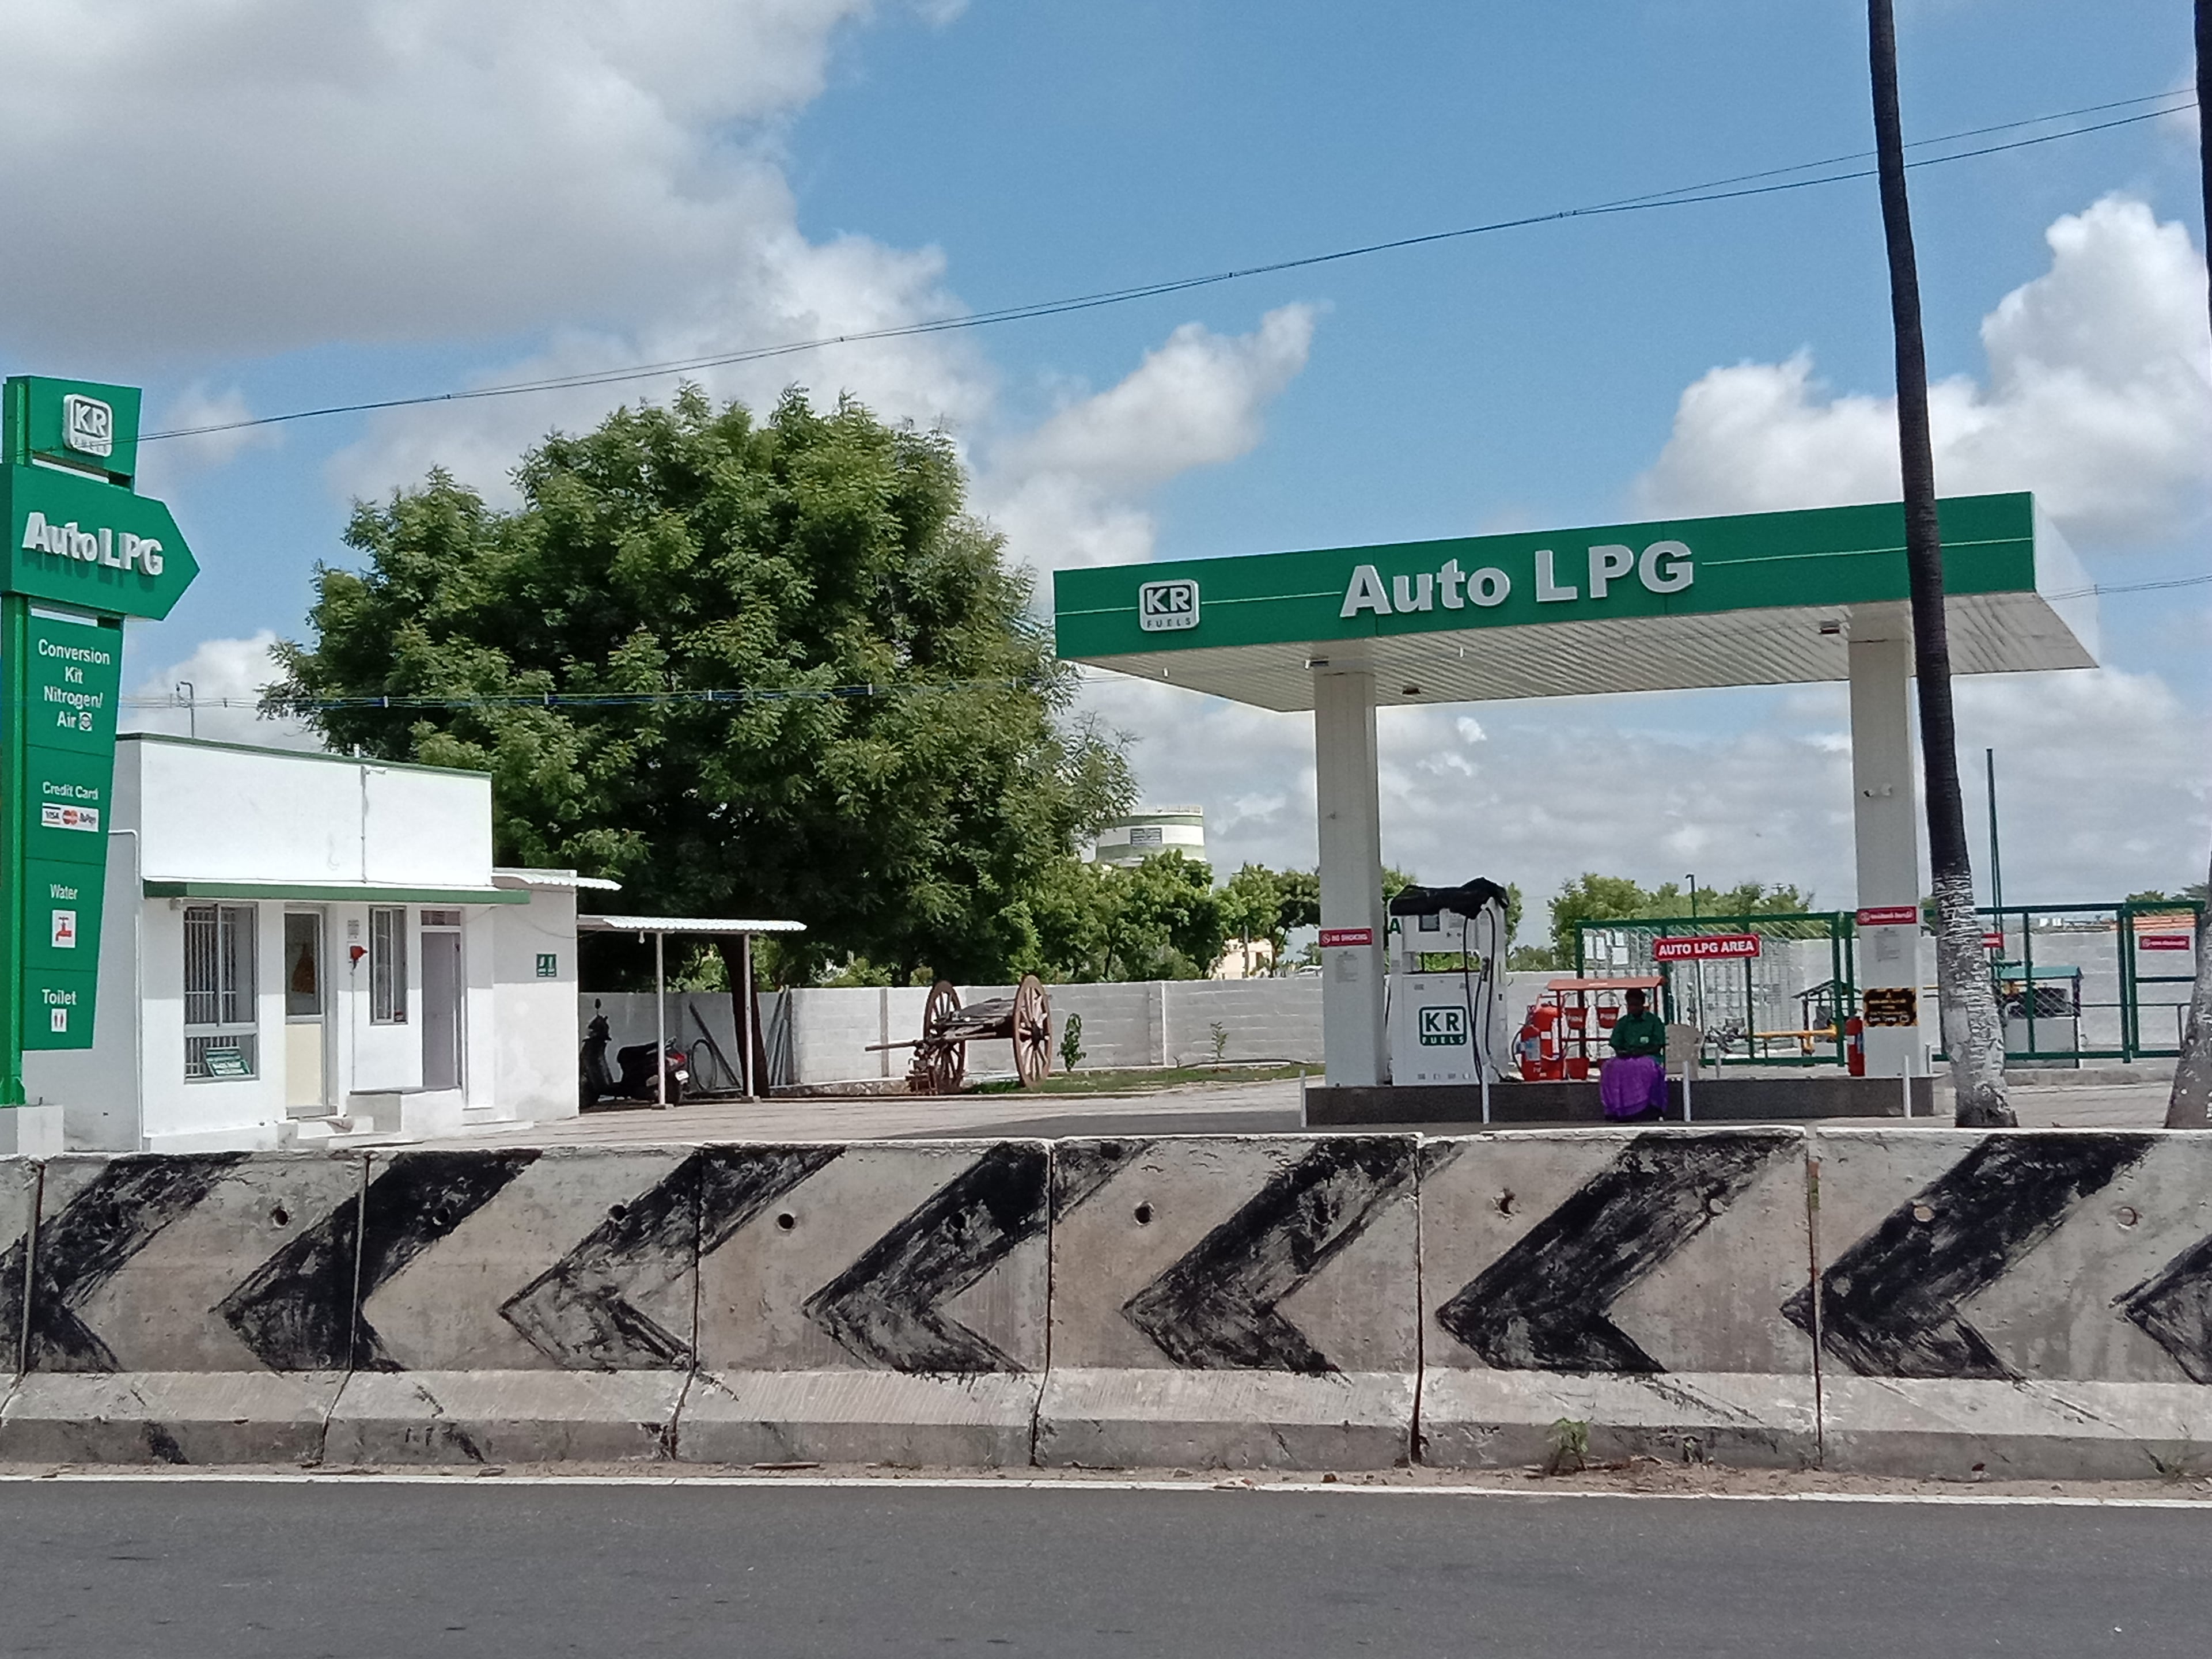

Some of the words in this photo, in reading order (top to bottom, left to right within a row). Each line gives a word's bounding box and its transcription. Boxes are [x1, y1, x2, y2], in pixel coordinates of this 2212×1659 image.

[75, 403, 106, 436] KR
[1340, 558, 1511, 618] Auto
[1535, 540, 1694, 603] LPG
[1146, 586, 1191, 614] KR
[1146, 617, 1191, 629] FUELS
[38, 638, 110, 665] Conversion
[65, 666, 84, 684] Kit
[44, 685, 103, 710] Nitrogen/
[56, 711, 77, 729] Air
[43, 781, 74, 797] Credit
[75, 785, 99, 800] Card
[50, 883, 78, 900] Water
[1658, 944, 1691, 956] AUTO
[1694, 942, 1718, 954] LPG
[1721, 940, 1755, 953] AREA
[42, 988, 77, 1005] Toilet
[1425, 1012, 1460, 1032] KR
[1422, 1036, 1464, 1044] FUELS
